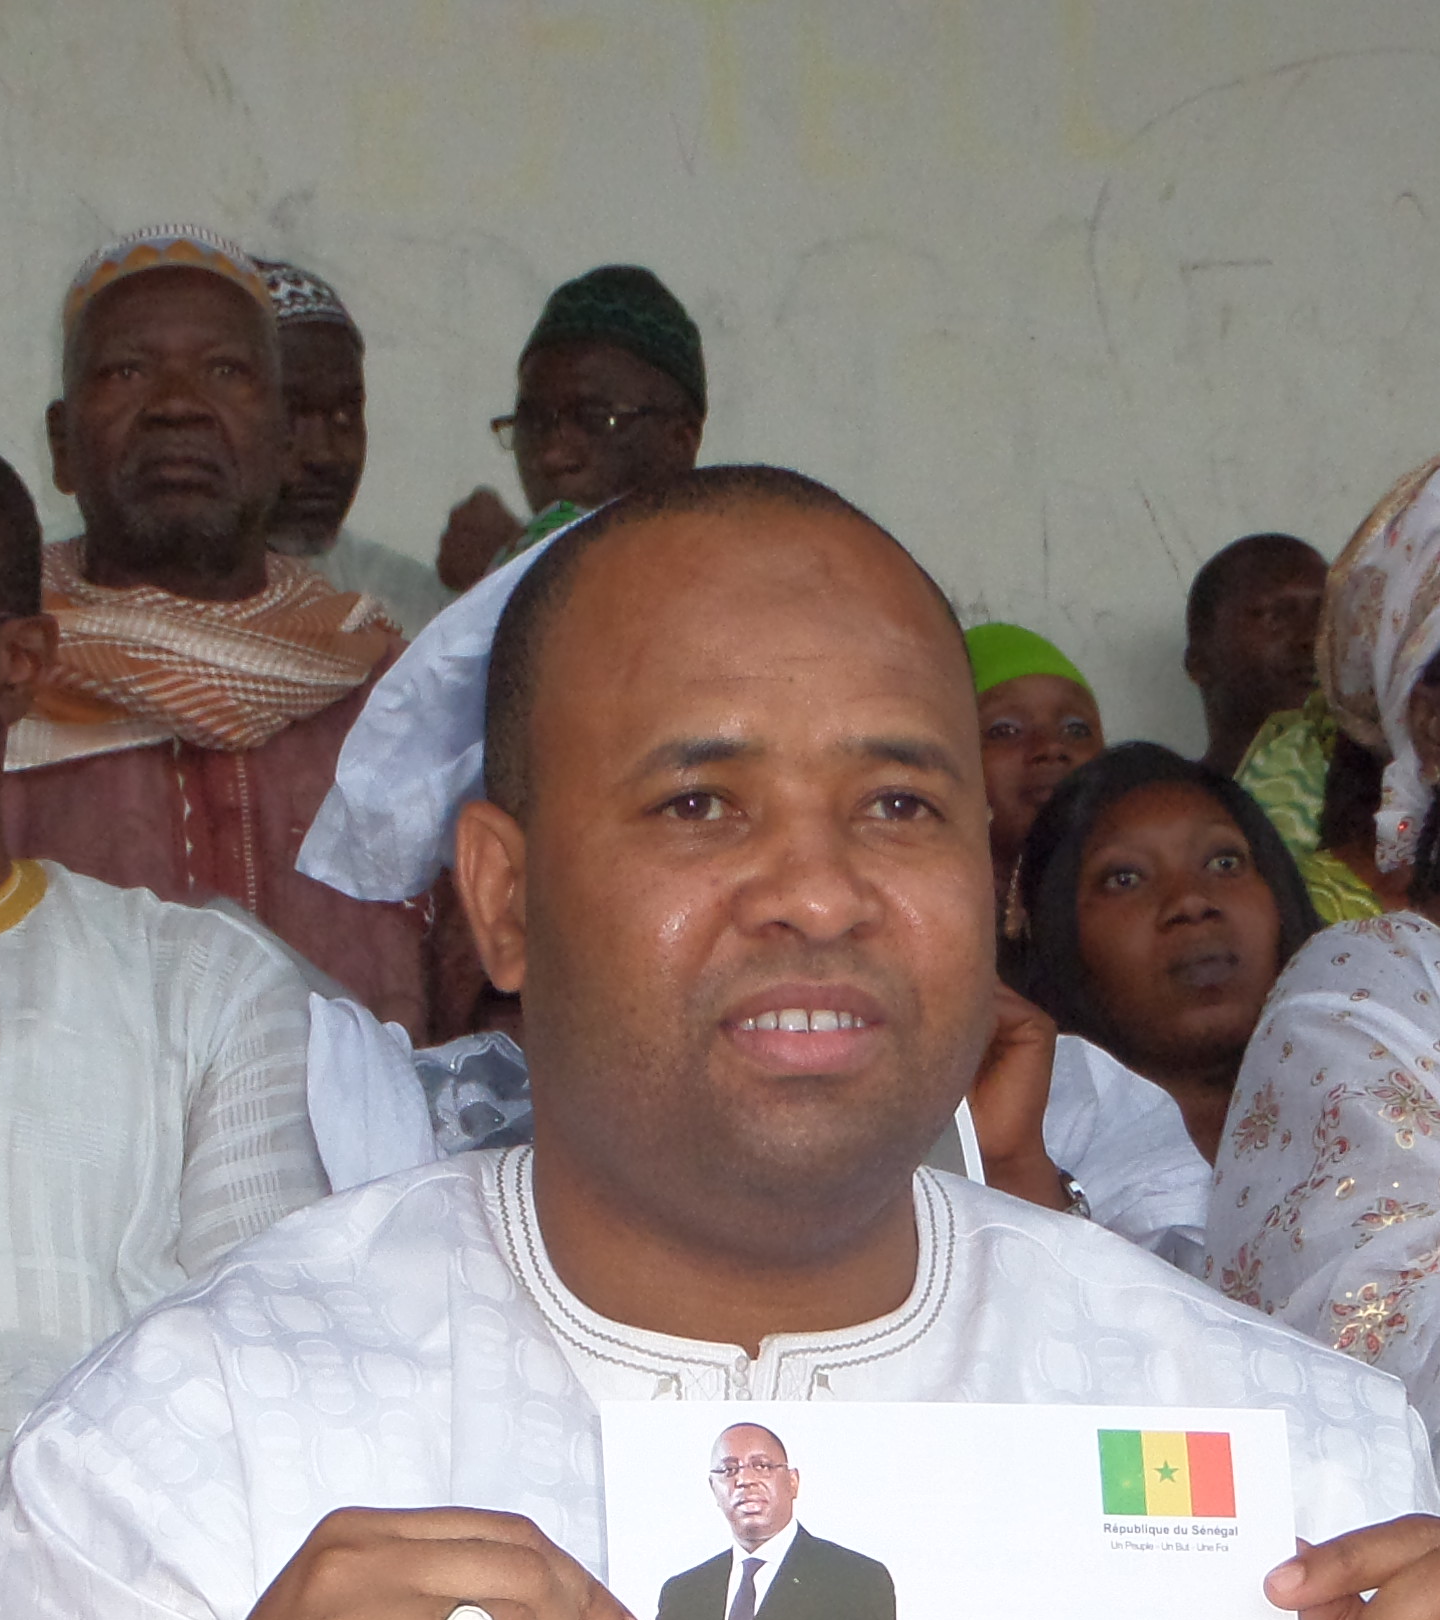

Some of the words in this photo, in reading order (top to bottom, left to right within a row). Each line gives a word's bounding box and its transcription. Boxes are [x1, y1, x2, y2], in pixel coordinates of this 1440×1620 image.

[1103, 1523, 1170, 1536] République
[1173, 1525, 1188, 1535] du
[1191, 1525, 1239, 1538] Sénégal
